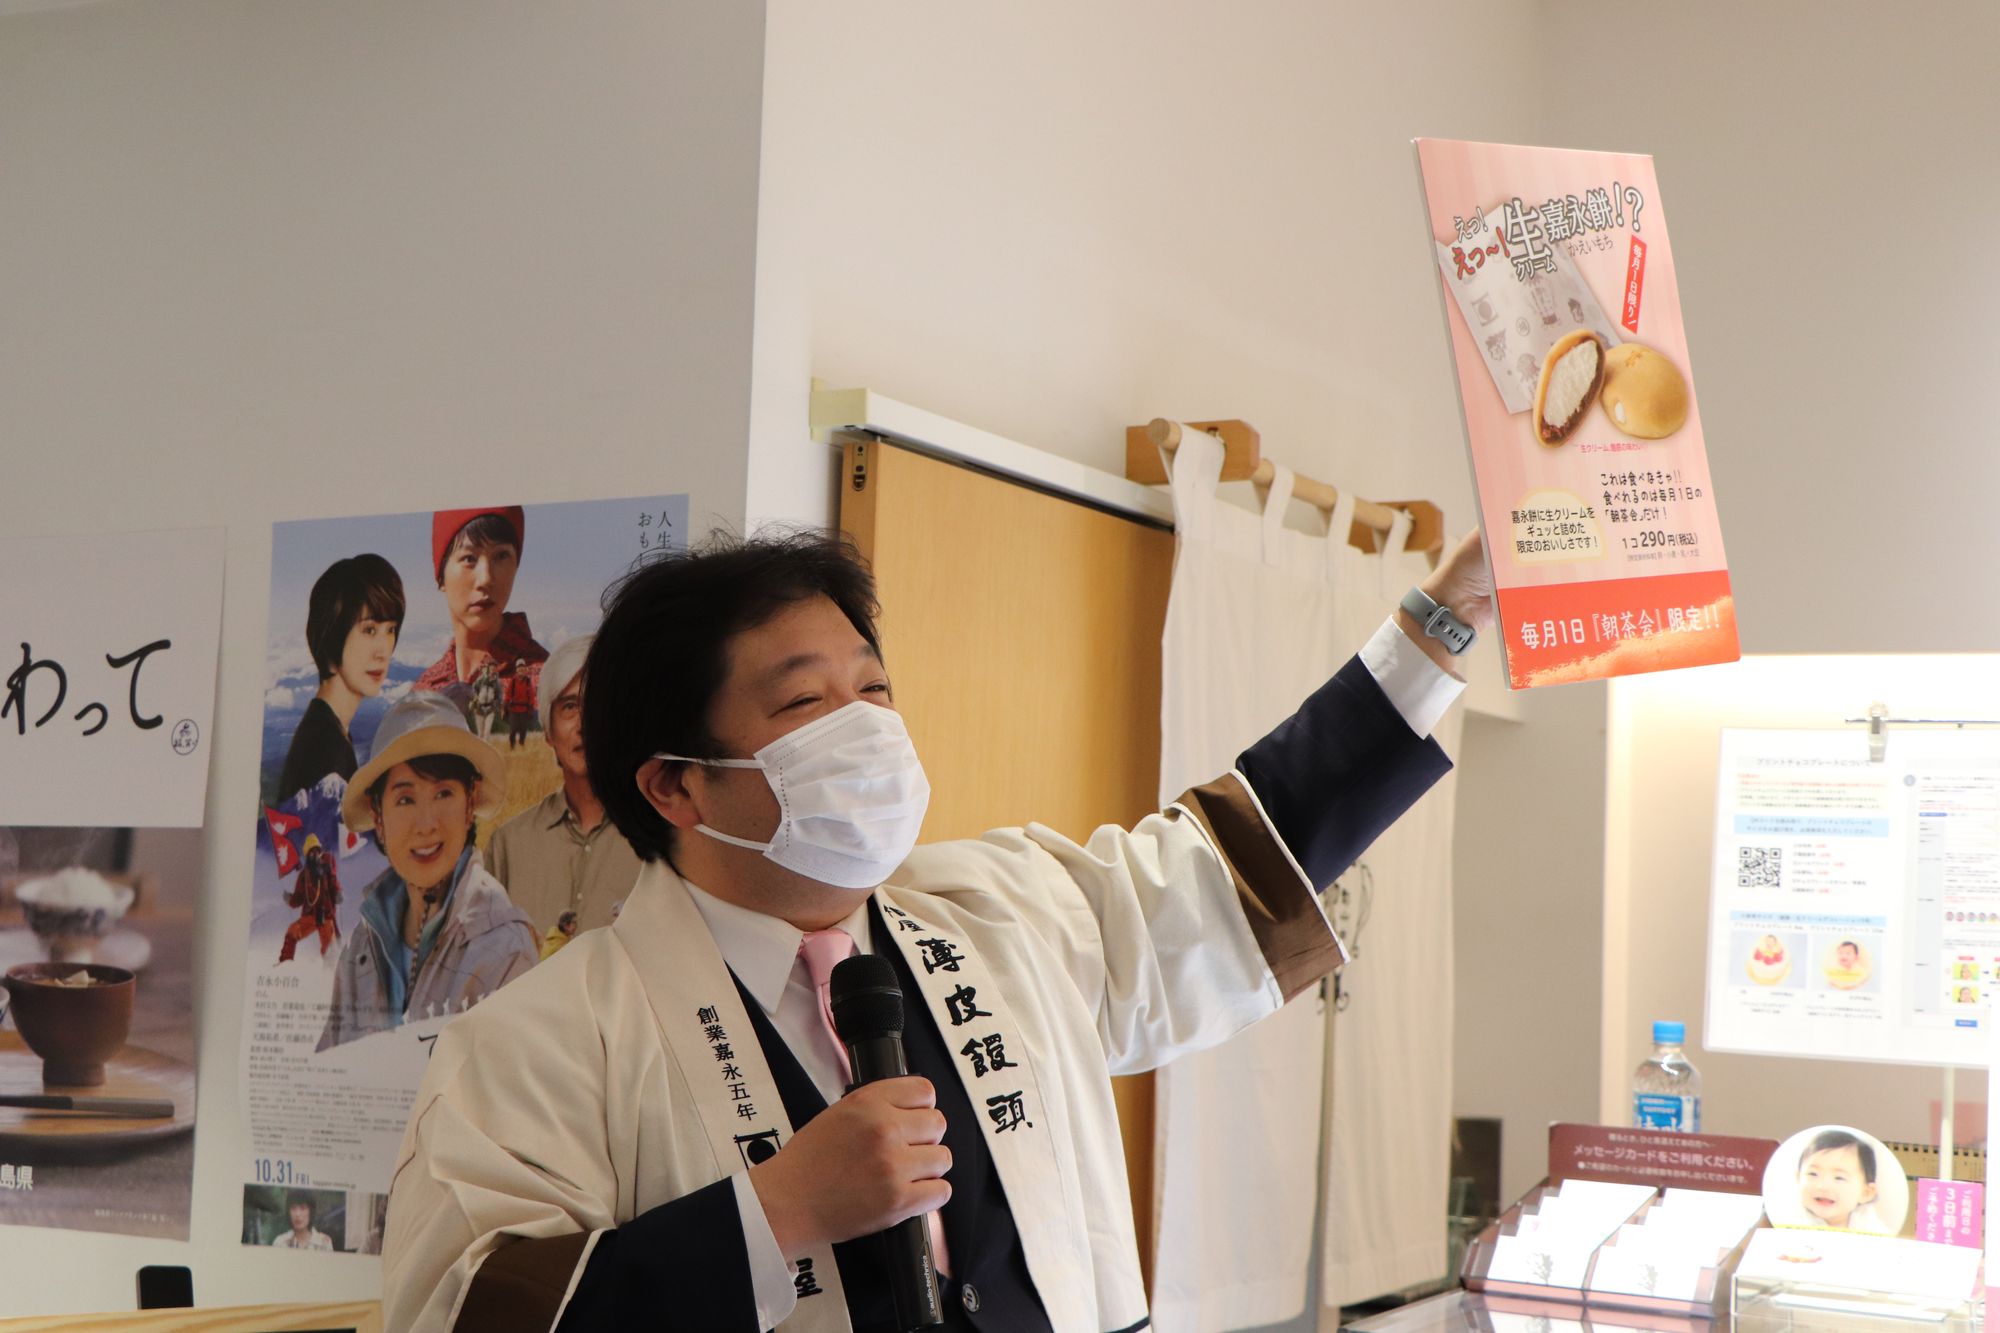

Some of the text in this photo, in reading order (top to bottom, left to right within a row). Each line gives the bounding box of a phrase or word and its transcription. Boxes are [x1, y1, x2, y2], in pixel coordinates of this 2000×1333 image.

[1515, 255, 1557, 282] クリーム
[1511, 506, 1596, 525] 嘉永餅に生クリームを
[1526, 522, 1586, 538] ギュッと詰めた
[696, 1005, 757, 1122] 創業嘉永五年
[1573, 1144, 1754, 1171] メッセージカードをご利用ください。
[254, 1158, 310, 1185] 10.31 FRI
[922, 1255, 935, 1309] audio-technica
